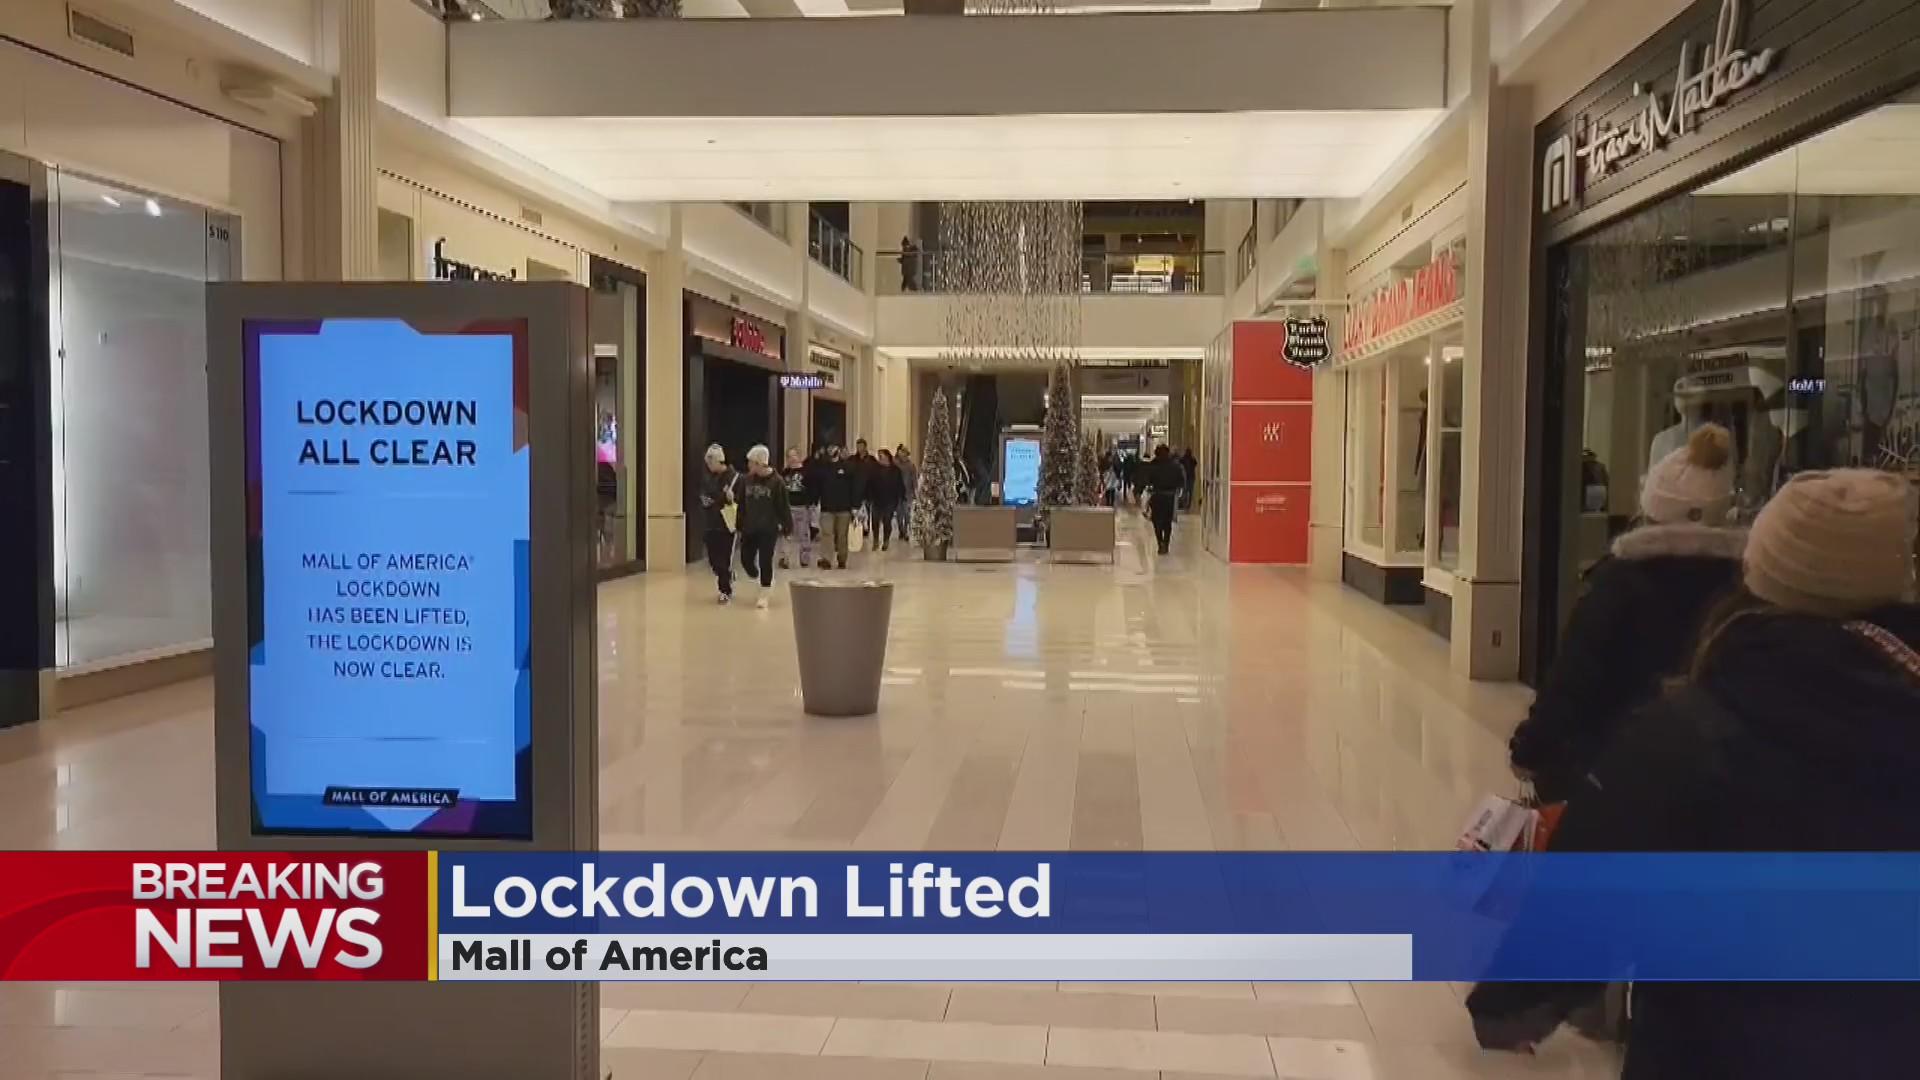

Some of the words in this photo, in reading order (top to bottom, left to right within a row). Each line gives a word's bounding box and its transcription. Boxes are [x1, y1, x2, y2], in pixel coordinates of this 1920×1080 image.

[297, 400, 477, 426] LOCKDOWN
[299, 439, 361, 466] ALL
[369, 440, 477, 466] CLEAR
[302, 553, 352, 570] MALL
[358, 553, 381, 570] OF
[336, 580, 440, 598] LOCKDOWN
[308, 607, 345, 624] HAS
[350, 608, 399, 625] BEEN
[404, 608, 470, 628] LIFTED,
[307, 634, 343, 651] THE
[347, 635, 450, 652] LOCKDOWN
[456, 637, 472, 652] IS
[334, 661, 375, 678] NOW
[380, 662, 445, 679] CLEAR.
[331, 791, 365, 802] MALL
[369, 791, 388, 803] OF
[391, 792, 450, 804] AMERICA
